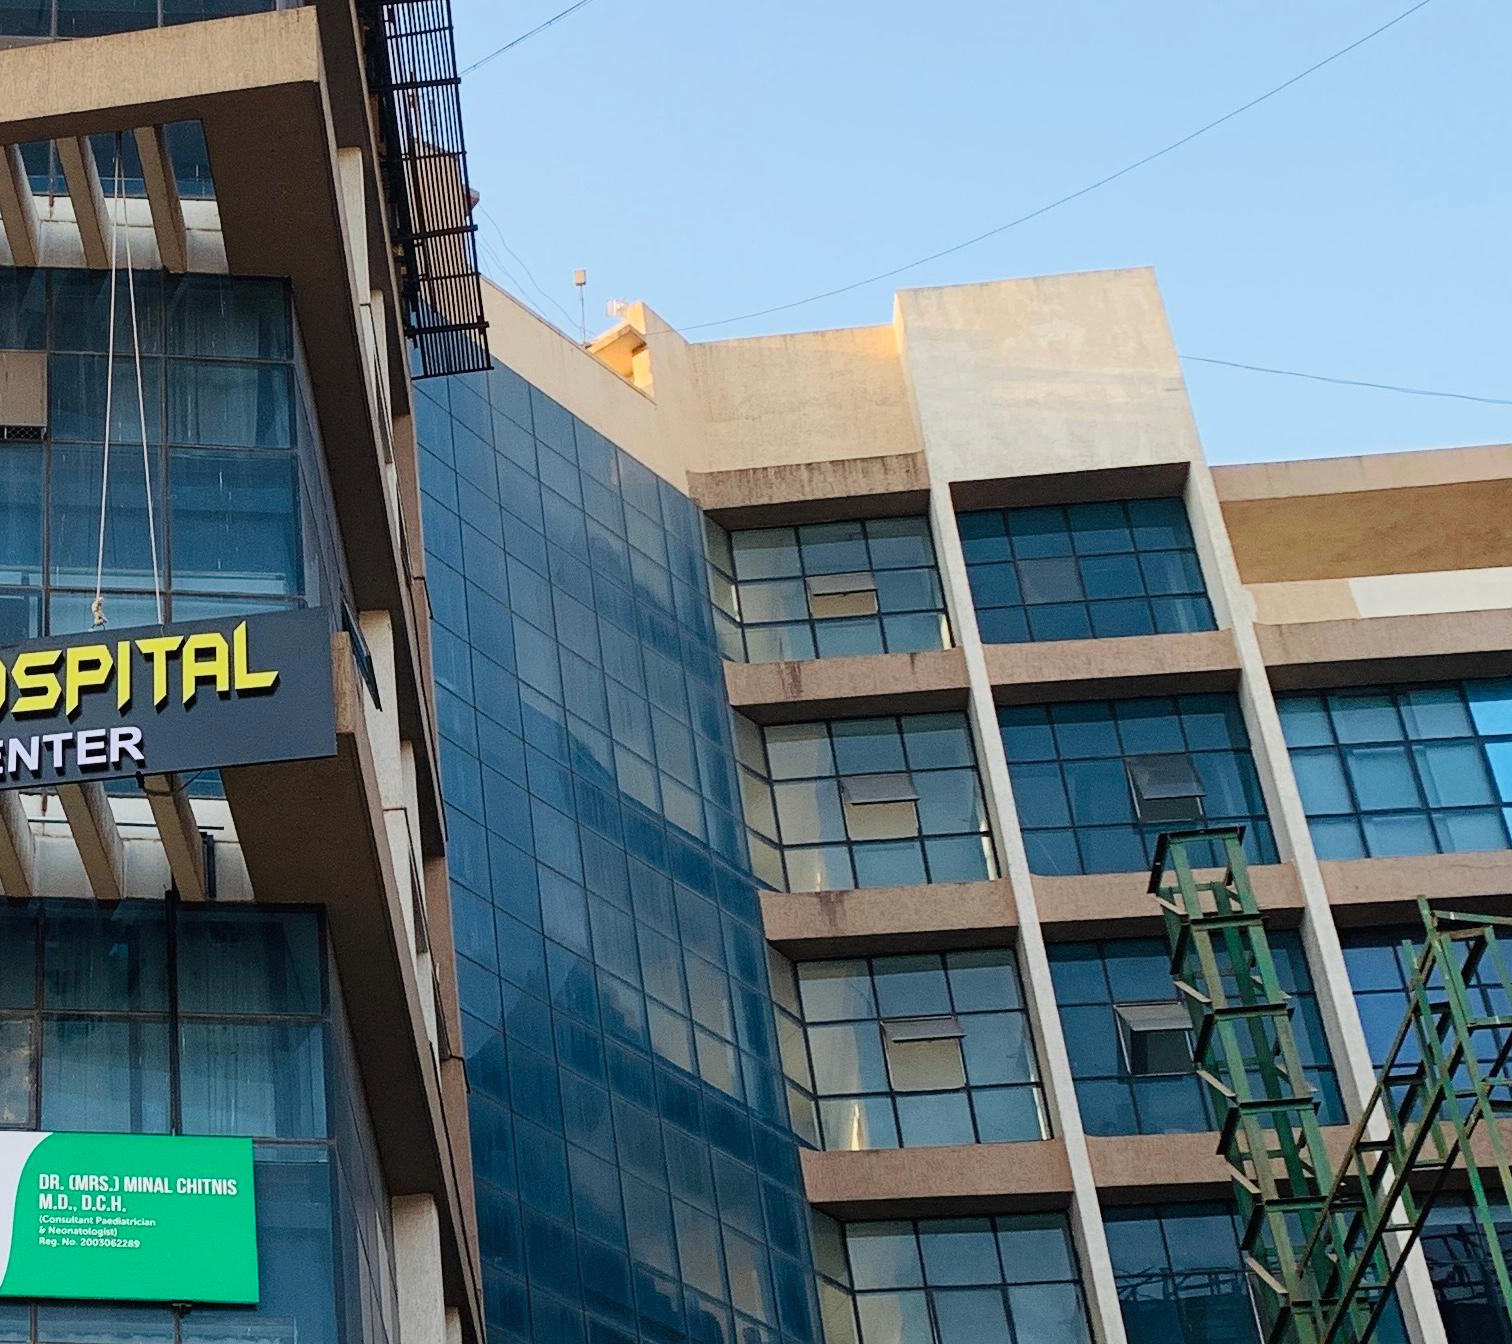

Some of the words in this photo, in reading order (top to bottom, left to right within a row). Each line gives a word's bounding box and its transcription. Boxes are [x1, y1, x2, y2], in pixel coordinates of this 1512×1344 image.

[39, 1174, 64, 1190] DR.
[69, 1175, 119, 1192] (MRS.)
[123, 1177, 173, 1194] MINAL
[176, 1179, 237, 1196] CHITNIS
[39, 1194, 78, 1212] M.D.,
[81, 1195, 127, 1212] D.C.H.
[39, 1214, 93, 1225] (Consultant
[96, 1216, 156, 1227] Paediatrician
[48, 1226, 117, 1238] Neonatologist)
[39, 1237, 59, 1248] Reg.
